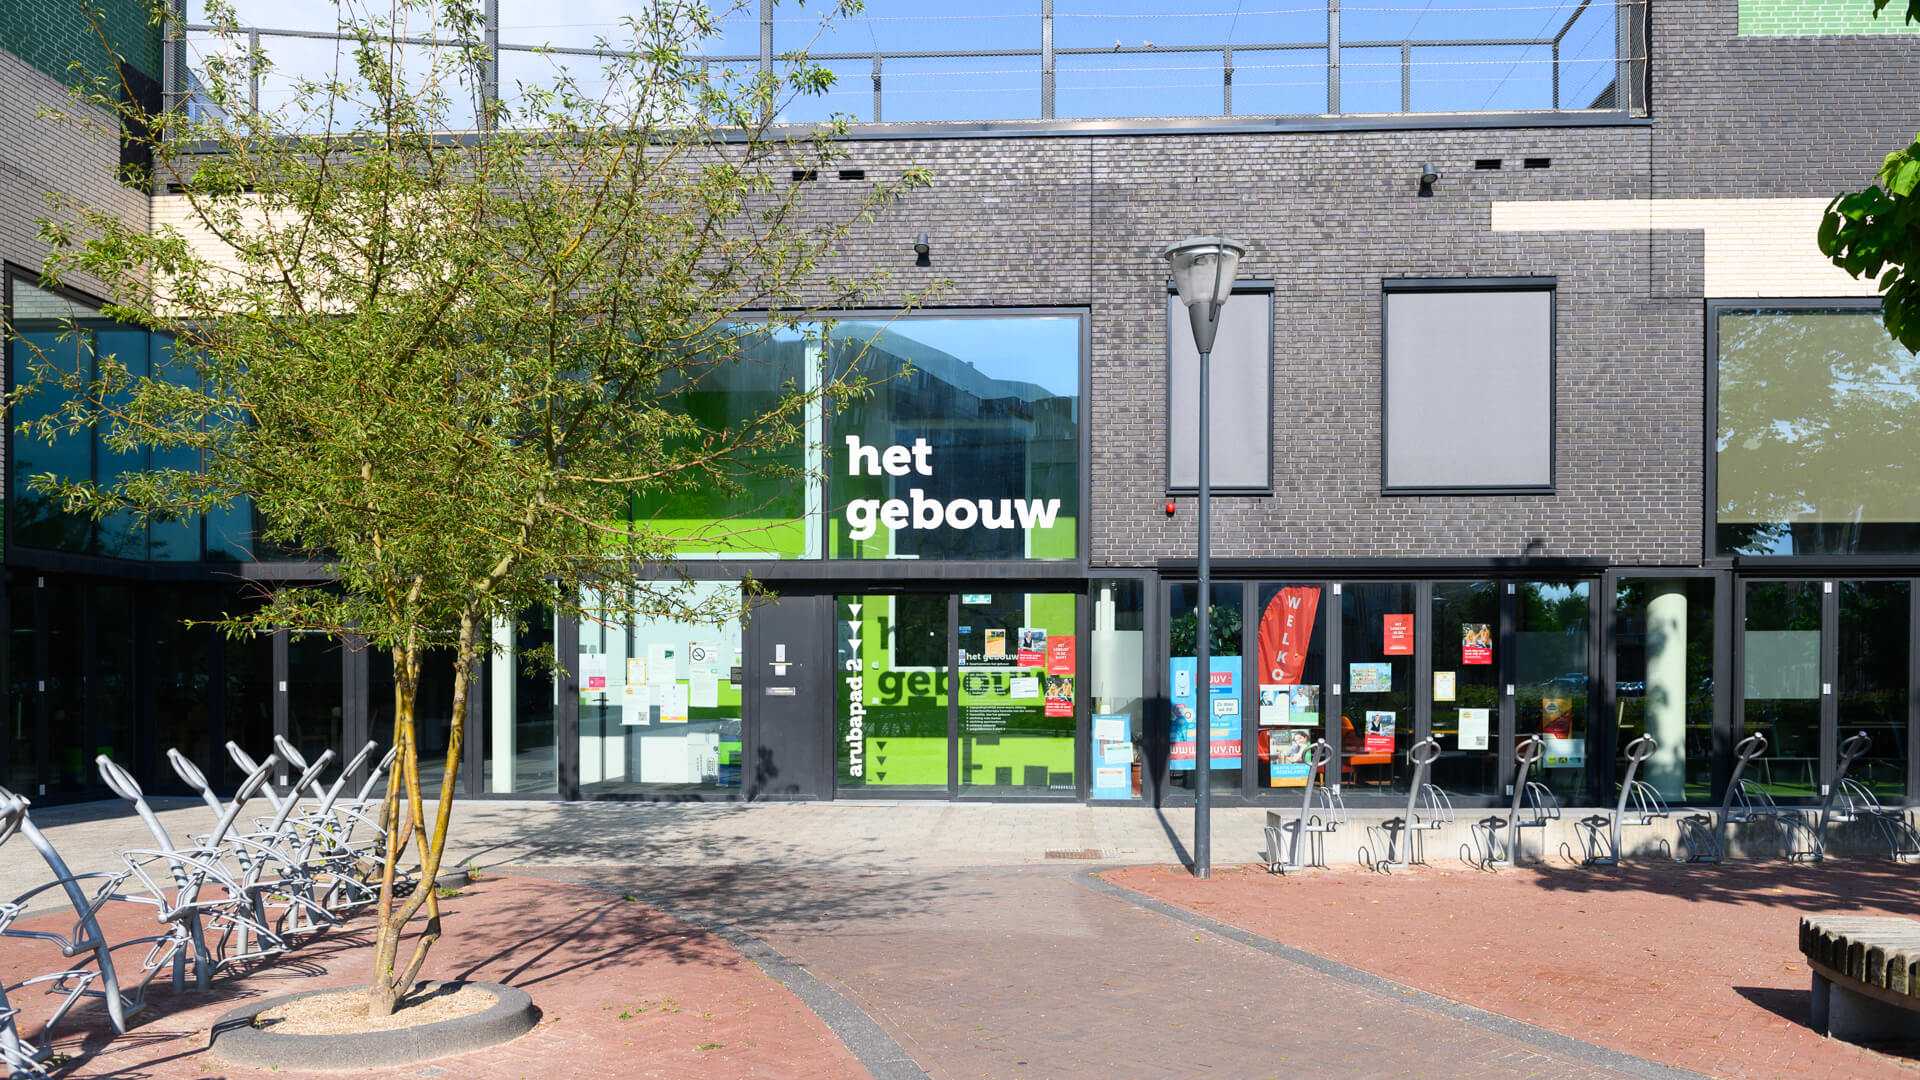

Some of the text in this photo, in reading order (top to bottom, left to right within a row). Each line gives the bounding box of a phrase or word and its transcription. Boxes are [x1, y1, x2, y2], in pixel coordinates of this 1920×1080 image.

[846, 435, 932, 476] het
[846, 488, 1061, 541] gebouw
[966, 652, 982, 660] het
[845, 658, 867, 777] arubapad 2
